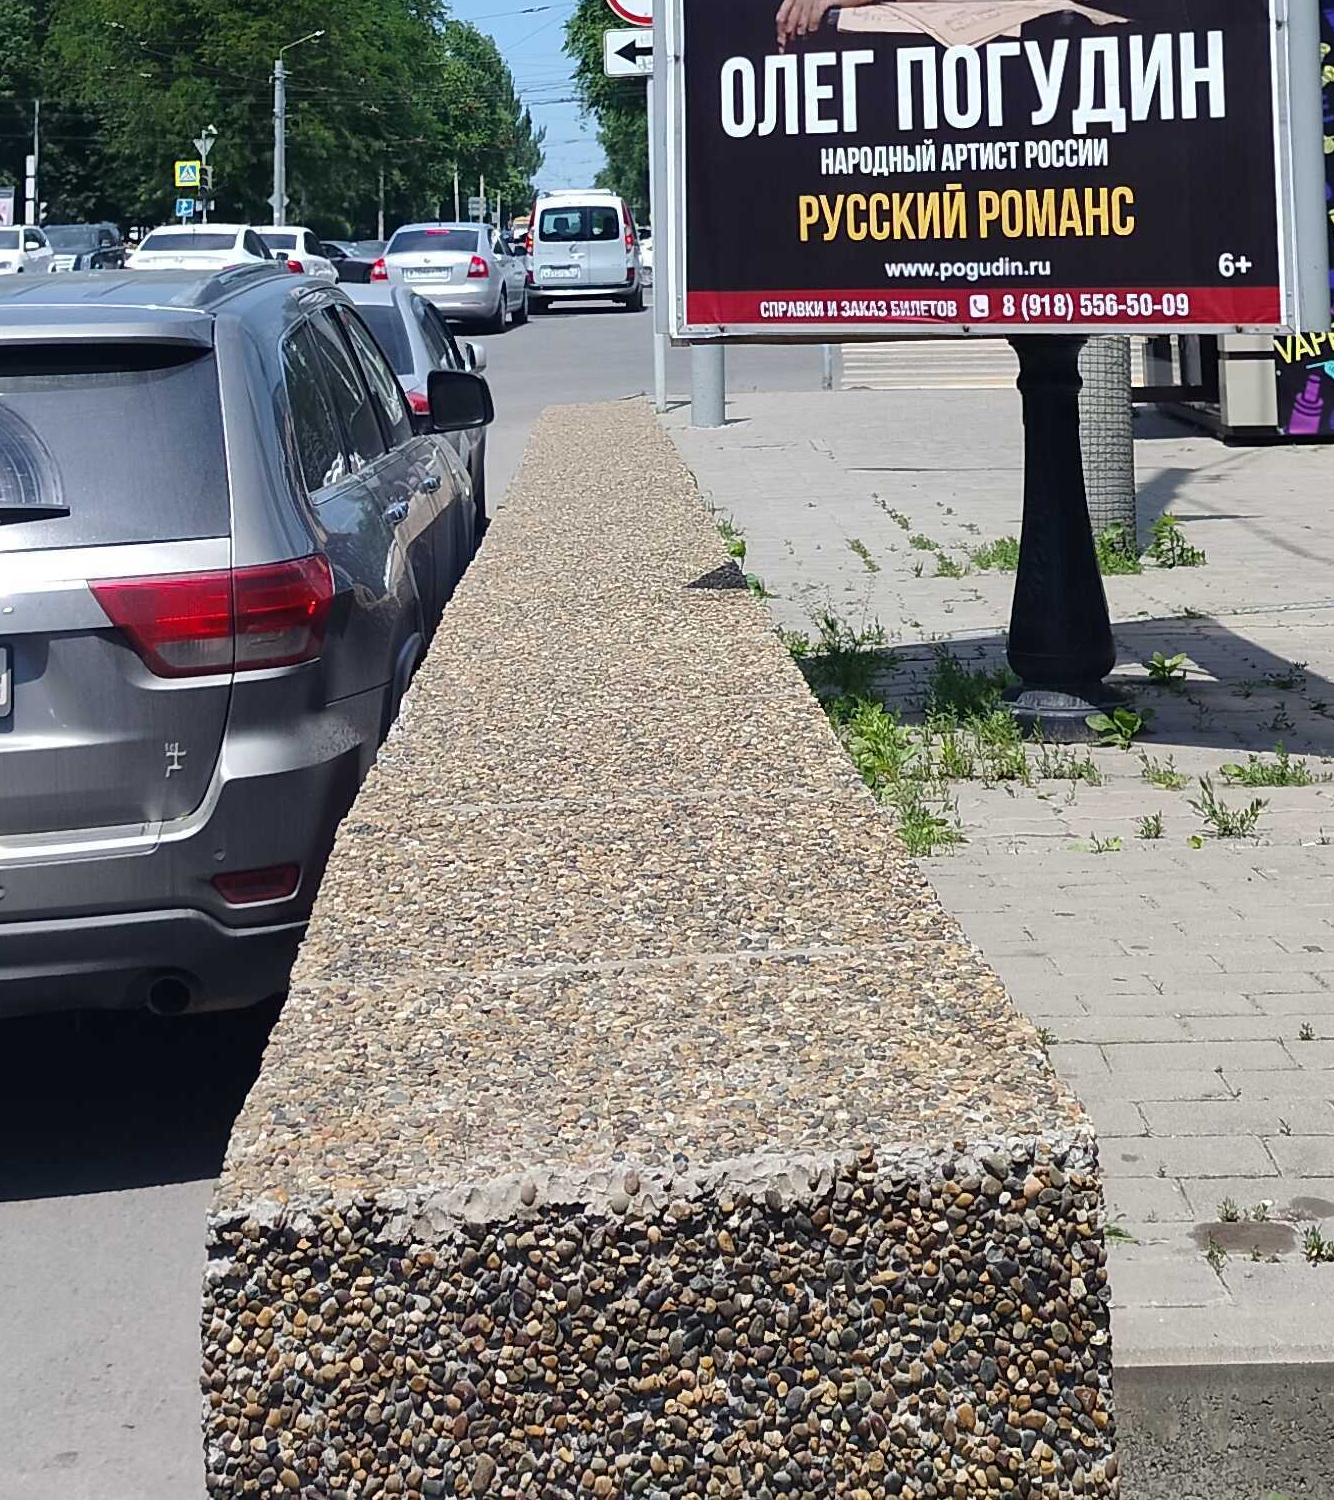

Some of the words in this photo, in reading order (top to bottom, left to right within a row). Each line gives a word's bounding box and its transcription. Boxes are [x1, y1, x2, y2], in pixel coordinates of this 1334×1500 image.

[720, 50, 874, 138] ОЛЕГ
[896, 30, 1226, 135] ПОГУДИН
[820, 139, 936, 176] НАРОДНЫЙ
[941, 141, 1019, 172] АРТИСТ
[1025, 138, 1108, 169] РОССИИ
[799, 183, 967, 242] РУССКИЙ
[978, 186, 1135, 239] РОМАНС
[885, 258, 1051, 281] www.pogudin.ru
[1218, 253, 1252, 278] 6+
[760, 301, 825, 319] СПРАВКИ
[828, 301, 838, 317] И
[840, 301, 888, 318] ЗАКАЗ
[890, 300, 957, 318] БИЛЕТОВ
[1002, 294, 1013, 316] 8
[1021, 293, 1073, 321] (918)
[1079, 293, 1189, 317] 556-50-09
